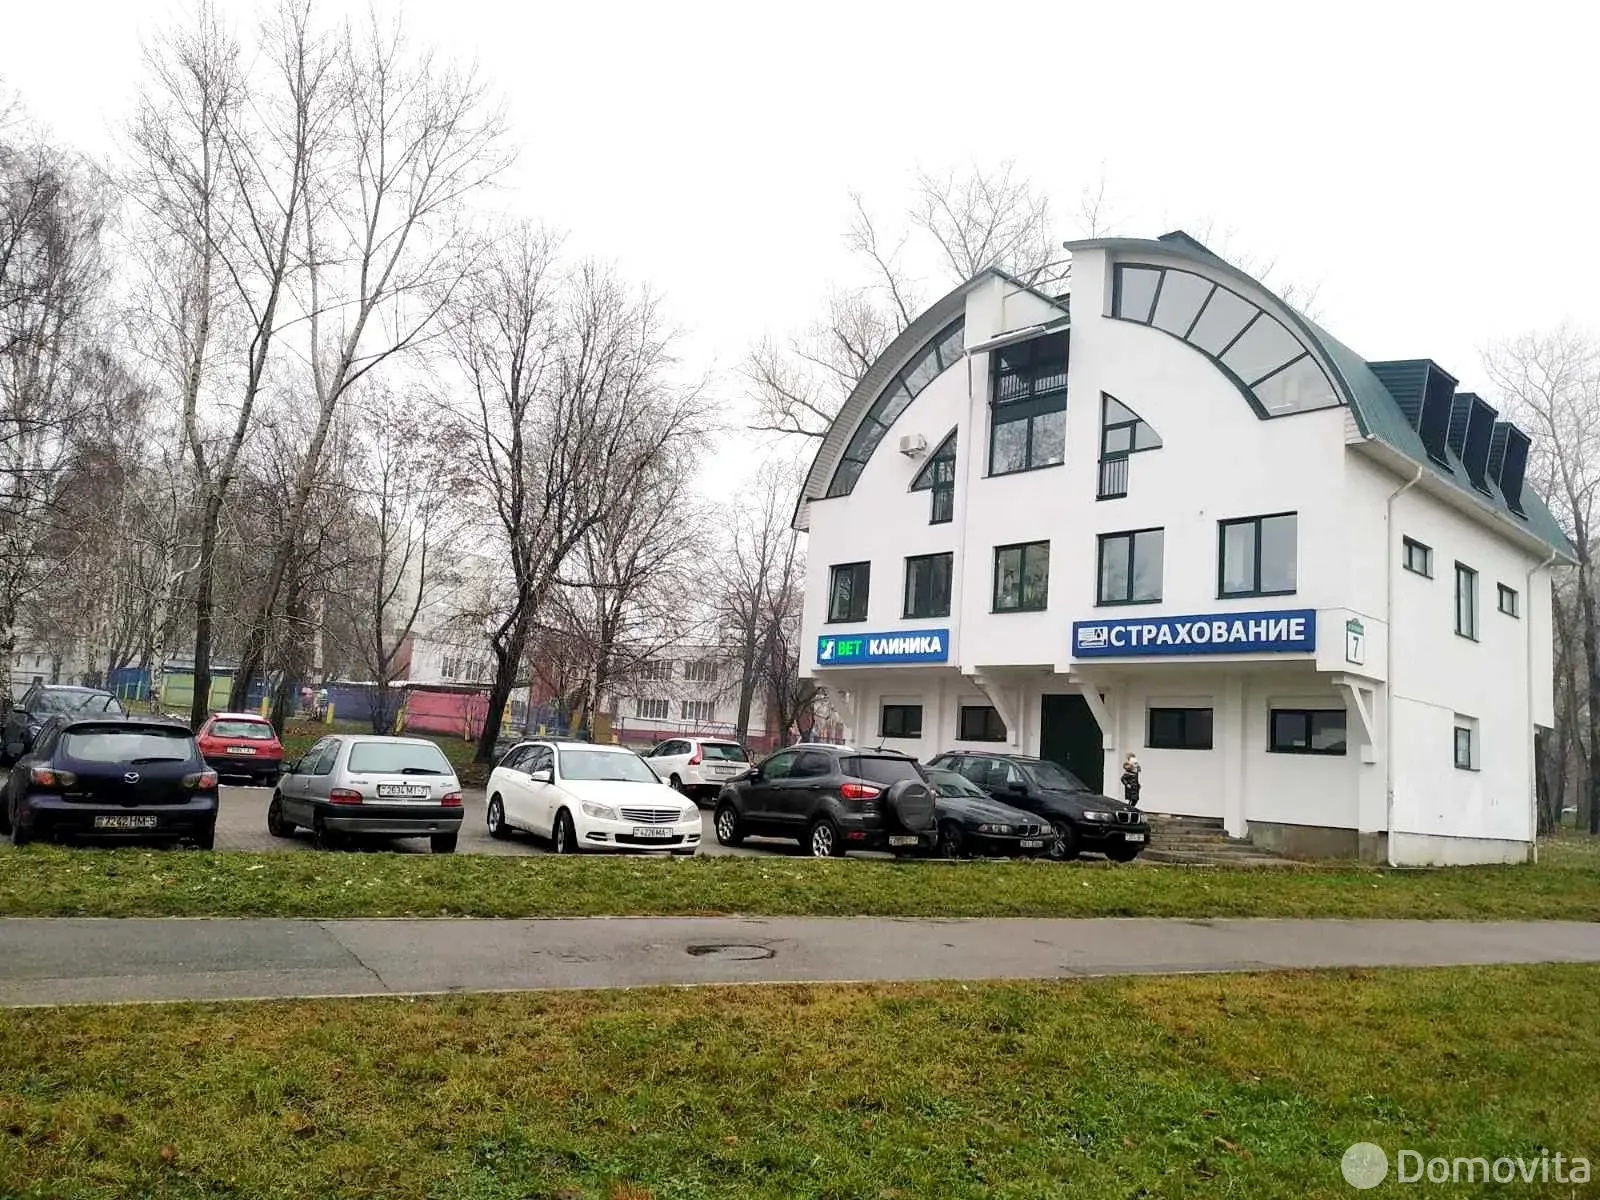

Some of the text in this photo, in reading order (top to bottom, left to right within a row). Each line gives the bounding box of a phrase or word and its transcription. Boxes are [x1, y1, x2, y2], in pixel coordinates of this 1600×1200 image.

[1110, 618, 1305, 647] СТРАХОВАНИЕ
[838, 636, 942, 656] ВЕТ КЛИНИКА
[1353, 636, 1360, 659] 7
